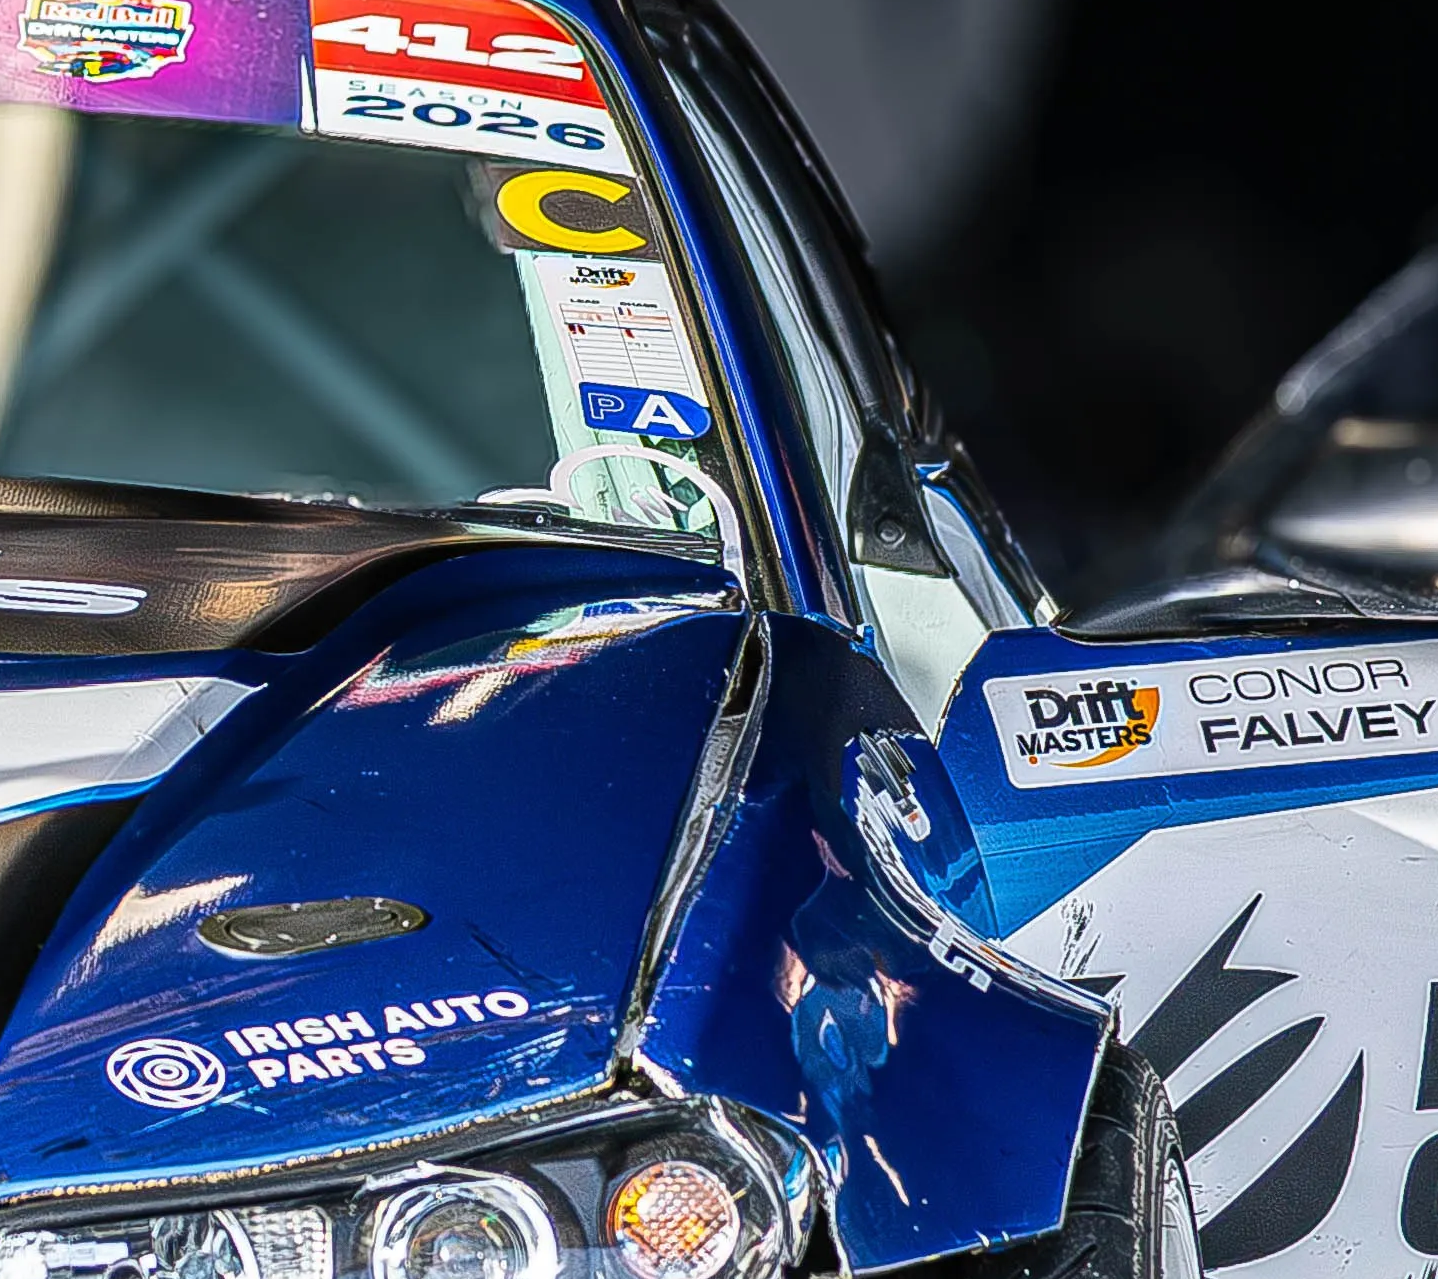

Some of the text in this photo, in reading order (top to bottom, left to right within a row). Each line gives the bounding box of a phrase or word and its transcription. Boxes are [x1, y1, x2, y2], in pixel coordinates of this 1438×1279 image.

[111, 6, 176, 27] Bull
[312, 14, 585, 81] 412
[348, 79, 523, 111] SEASON
[342, 95, 607, 151] 2026
[496, 170, 647, 254] C
[575, 265, 628, 280] Drift
[633, 395, 694, 435] A
[1024, 678, 1137, 726] Drift
[1187, 657, 1412, 706] CONOR
[1016, 724, 1152, 758] MASTERS
[1202, 699, 1432, 754] FALVEY
[224, 990, 530, 1059] IRISH AUTO
[247, 1037, 427, 1089] PARTS
